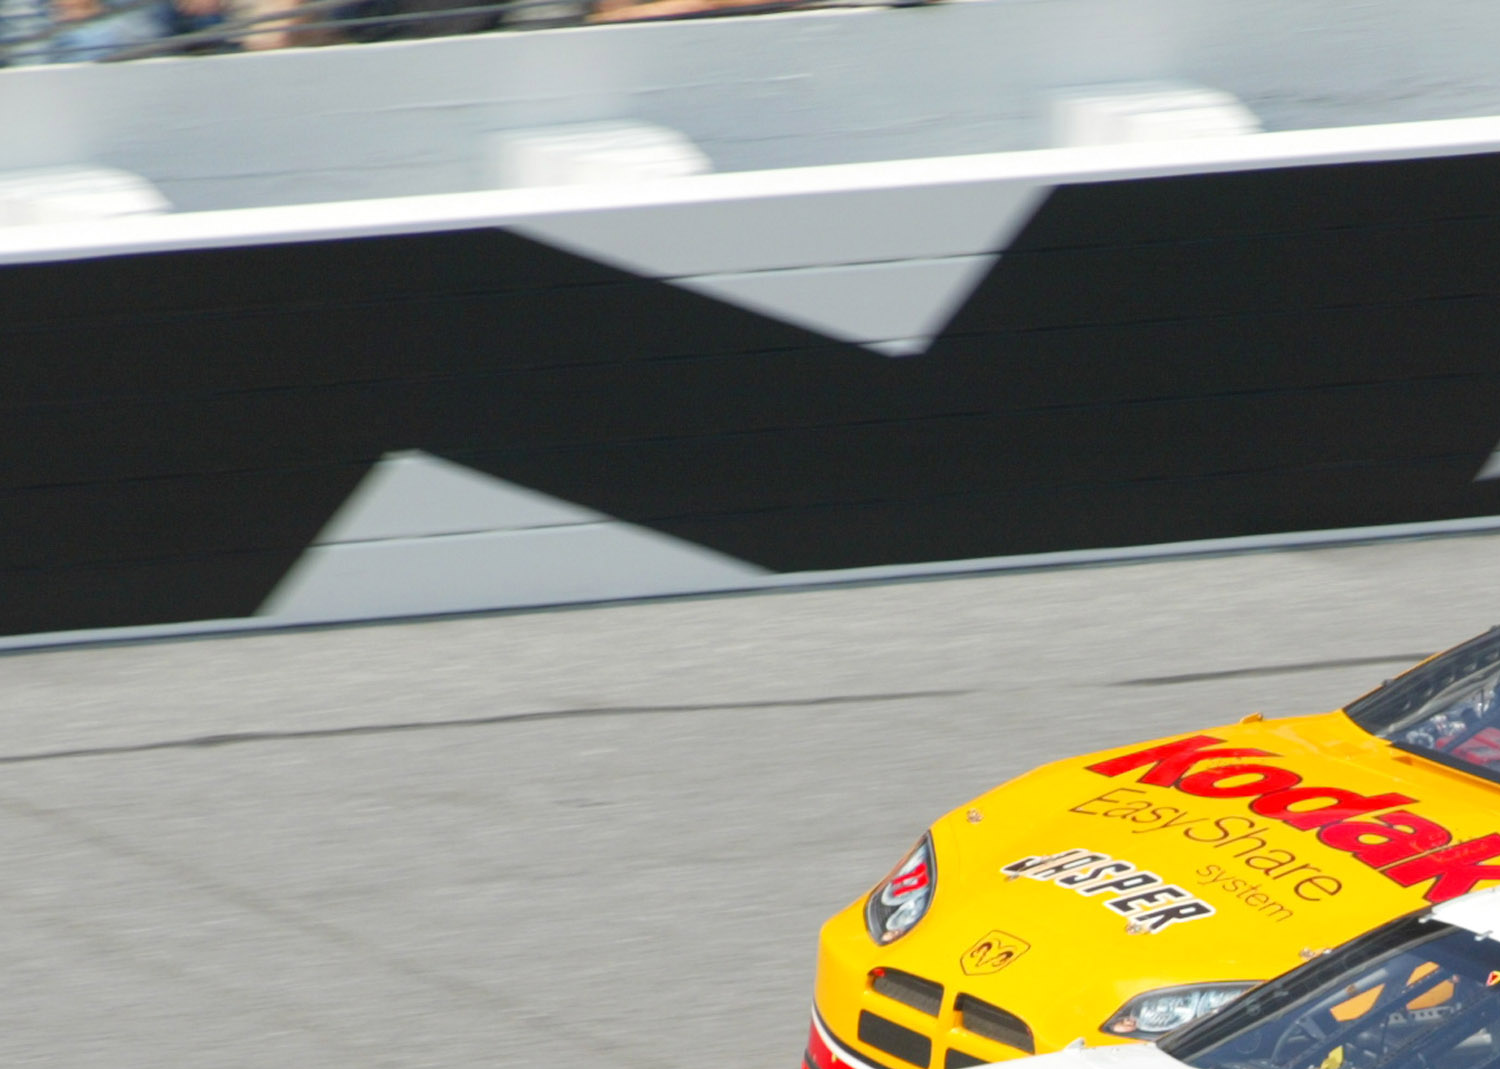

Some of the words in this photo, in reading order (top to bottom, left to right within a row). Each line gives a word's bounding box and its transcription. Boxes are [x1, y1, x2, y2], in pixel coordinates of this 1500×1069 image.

[1068, 788, 1343, 902] EasyShare
[1001, 848, 1215, 933] JASPER
[1195, 863, 1294, 923] system
